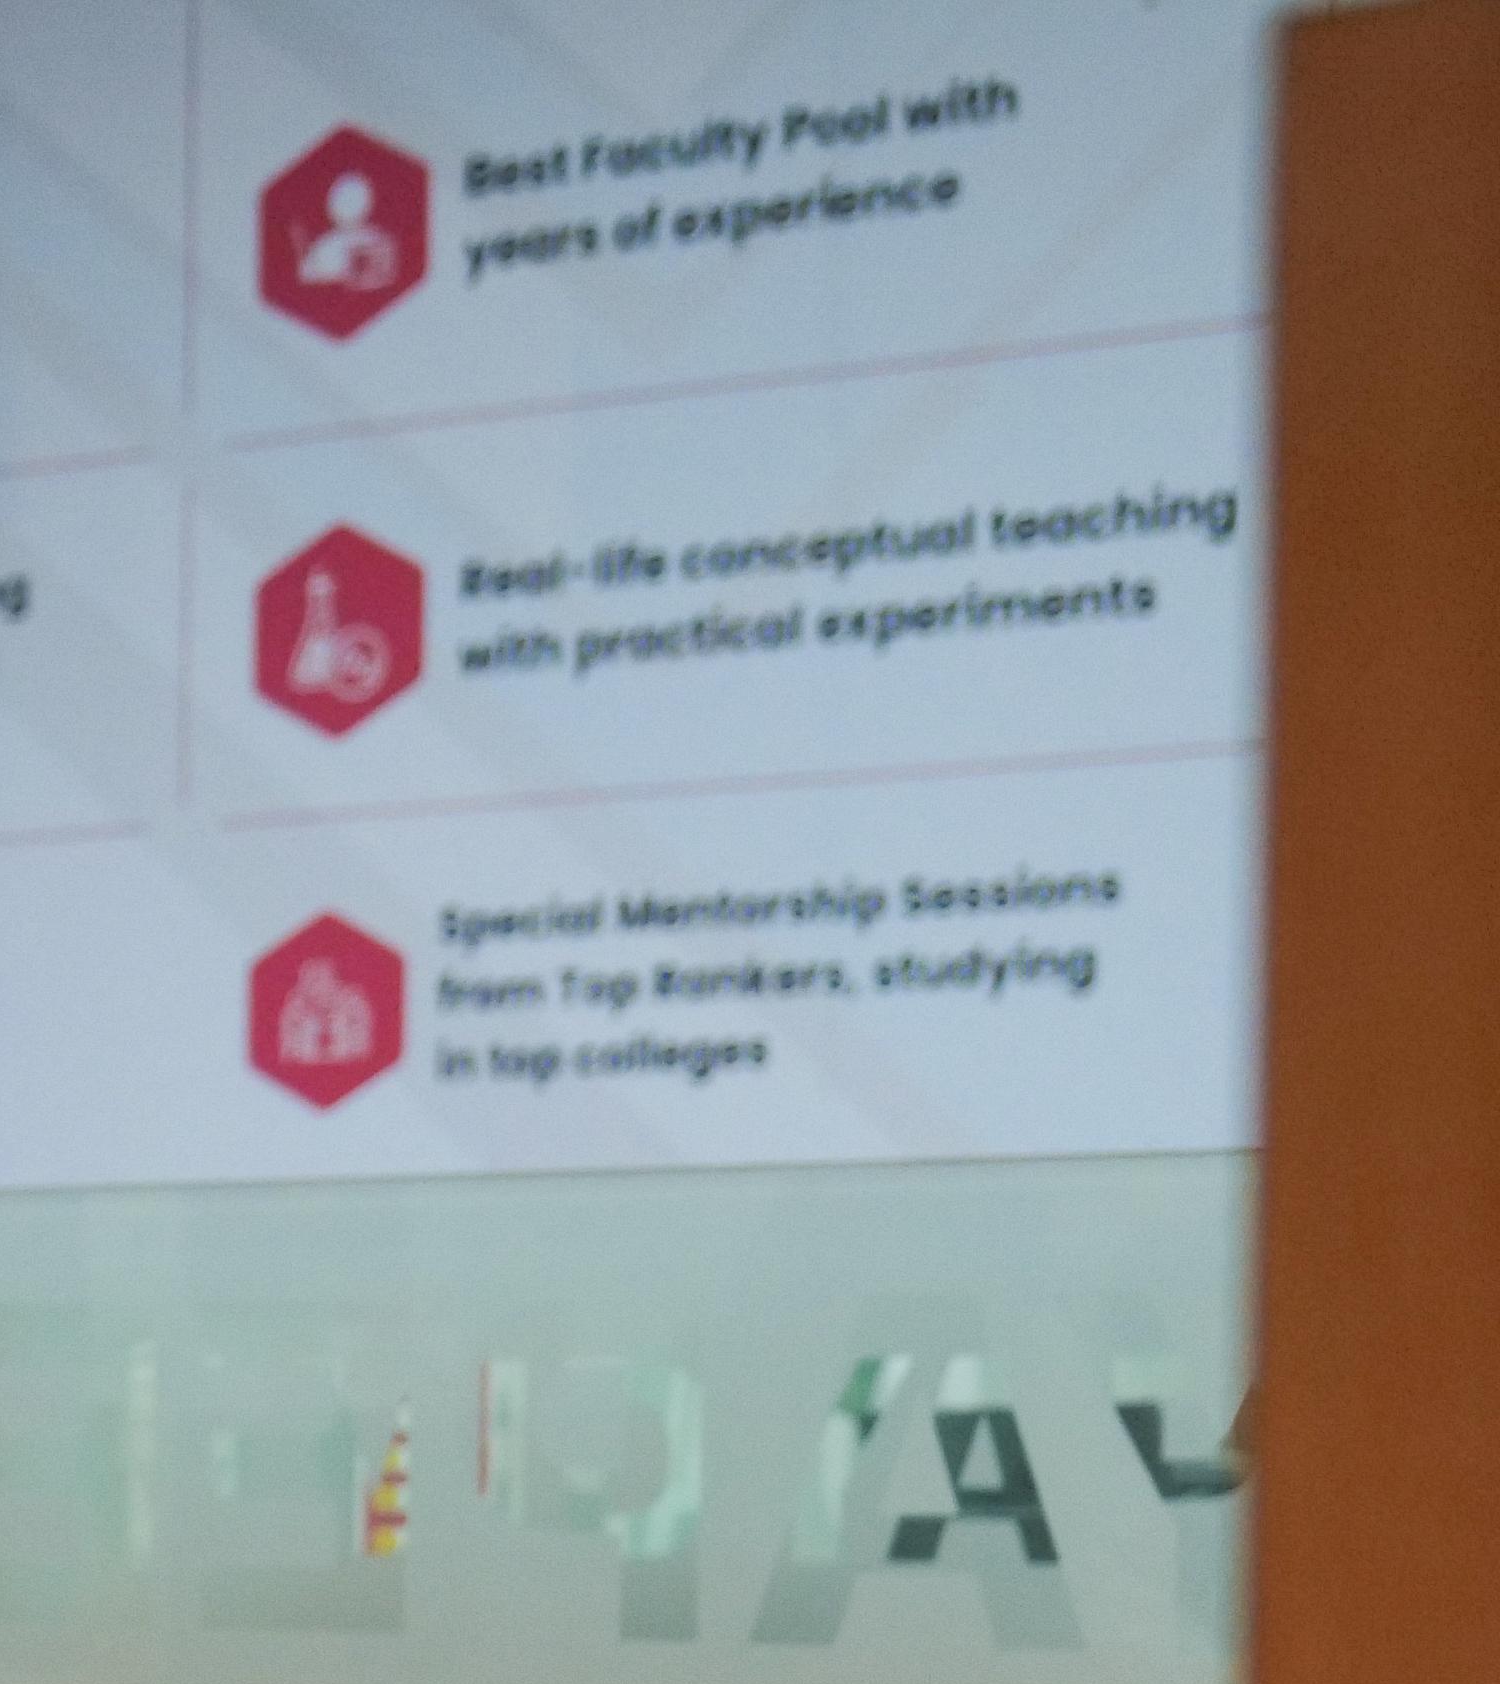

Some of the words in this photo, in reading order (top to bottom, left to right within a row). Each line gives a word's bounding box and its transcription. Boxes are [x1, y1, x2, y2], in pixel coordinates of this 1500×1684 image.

[464, 142, 567, 196] Best
[581, 114, 766, 174] Faculty
[781, 95, 891, 147] Pool
[902, 76, 1020, 136] with
[464, 220, 598, 288] years
[611, 197, 660, 252] of
[672, 170, 963, 249] experience
[460, 538, 667, 597] Real-life
[680, 505, 977, 580] conceptual
[988, 480, 1238, 545] teaching
[462, 625, 563, 677] with
[573, 605, 802, 682] practical
[818, 577, 1157, 656] experiments
[440, 895, 604, 957] Special
[615, 876, 886, 935] Mentorship
[904, 862, 1120, 915] Sessions
[439, 973, 543, 1010] from
[561, 965, 638, 1015] Top
[876, 940, 1096, 1000] studying
[438, 1042, 475, 1080] in
[489, 1043, 560, 1088] top
[574, 1034, 768, 1084] colleges
